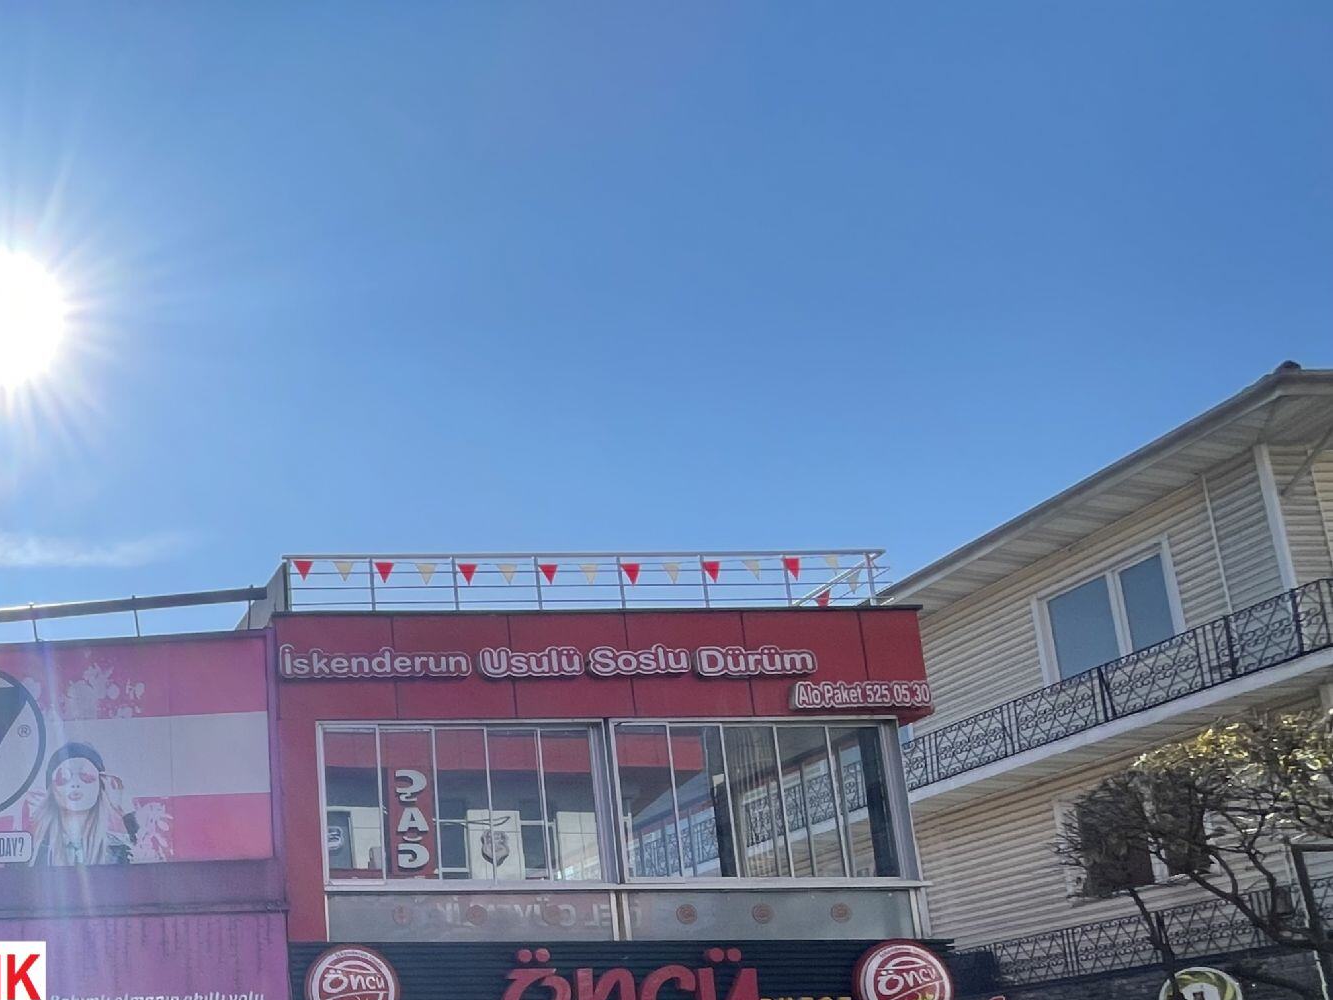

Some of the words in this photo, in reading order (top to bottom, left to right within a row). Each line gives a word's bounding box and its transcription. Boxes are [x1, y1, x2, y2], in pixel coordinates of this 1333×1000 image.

[281, 645, 470, 678] İskenderun
[480, 647, 584, 678] Usulü
[588, 644, 690, 677] Soslu
[696, 646, 816, 677] Dürüm
[796, 682, 820, 707] Alo
[825, 682, 863, 707] Paket
[865, 681, 891, 706] 525
[893, 681, 910, 705] 05
[911, 681, 930, 704] 30
